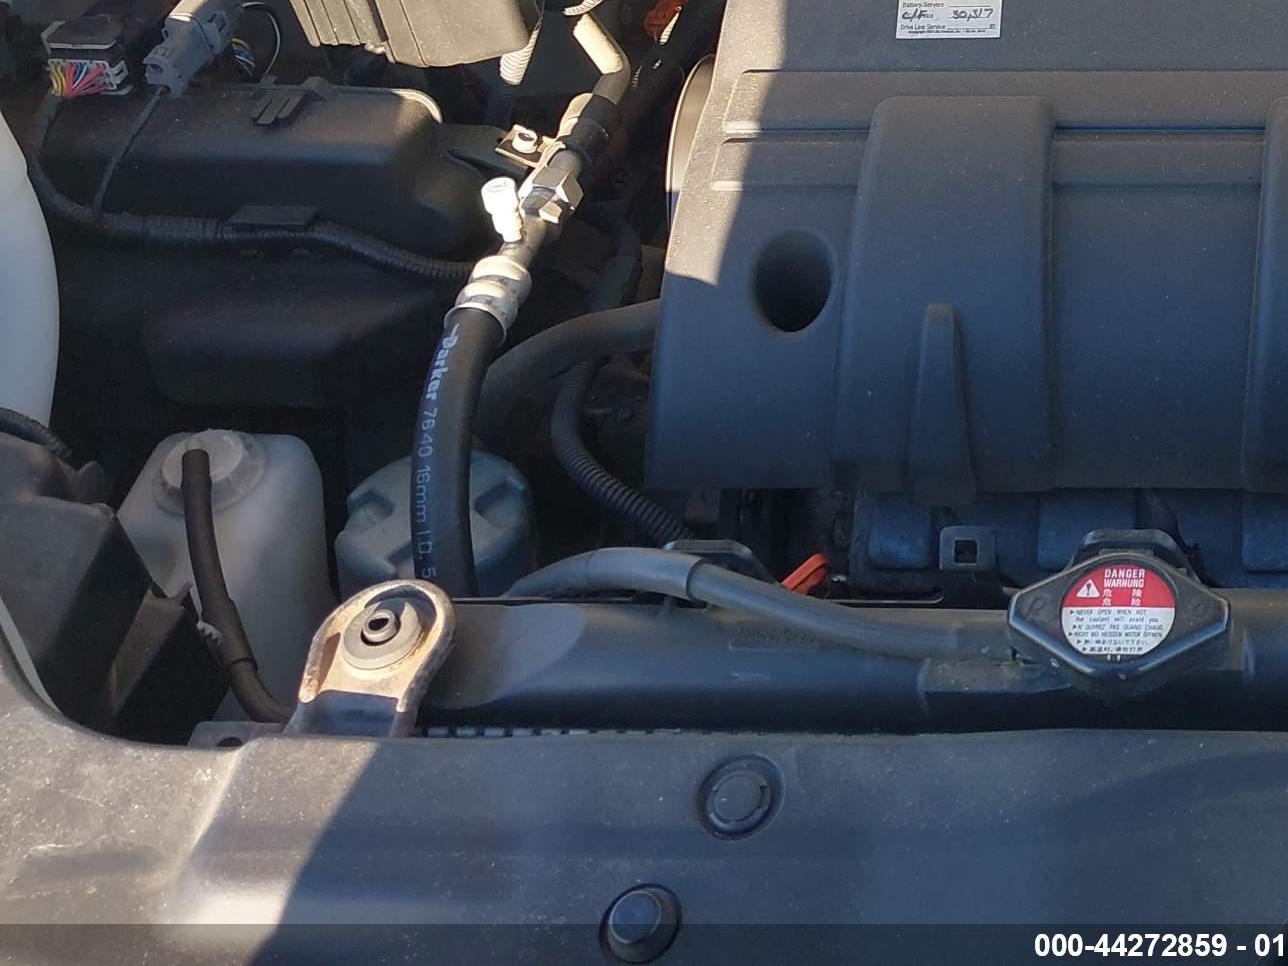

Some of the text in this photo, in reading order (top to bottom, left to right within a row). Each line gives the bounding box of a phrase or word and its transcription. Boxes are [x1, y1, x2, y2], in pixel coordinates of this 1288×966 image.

[425, 322, 462, 402] Parker
[1104, 569, 1145, 578] DANGER
[1103, 578, 1144, 588] WARNUNG
